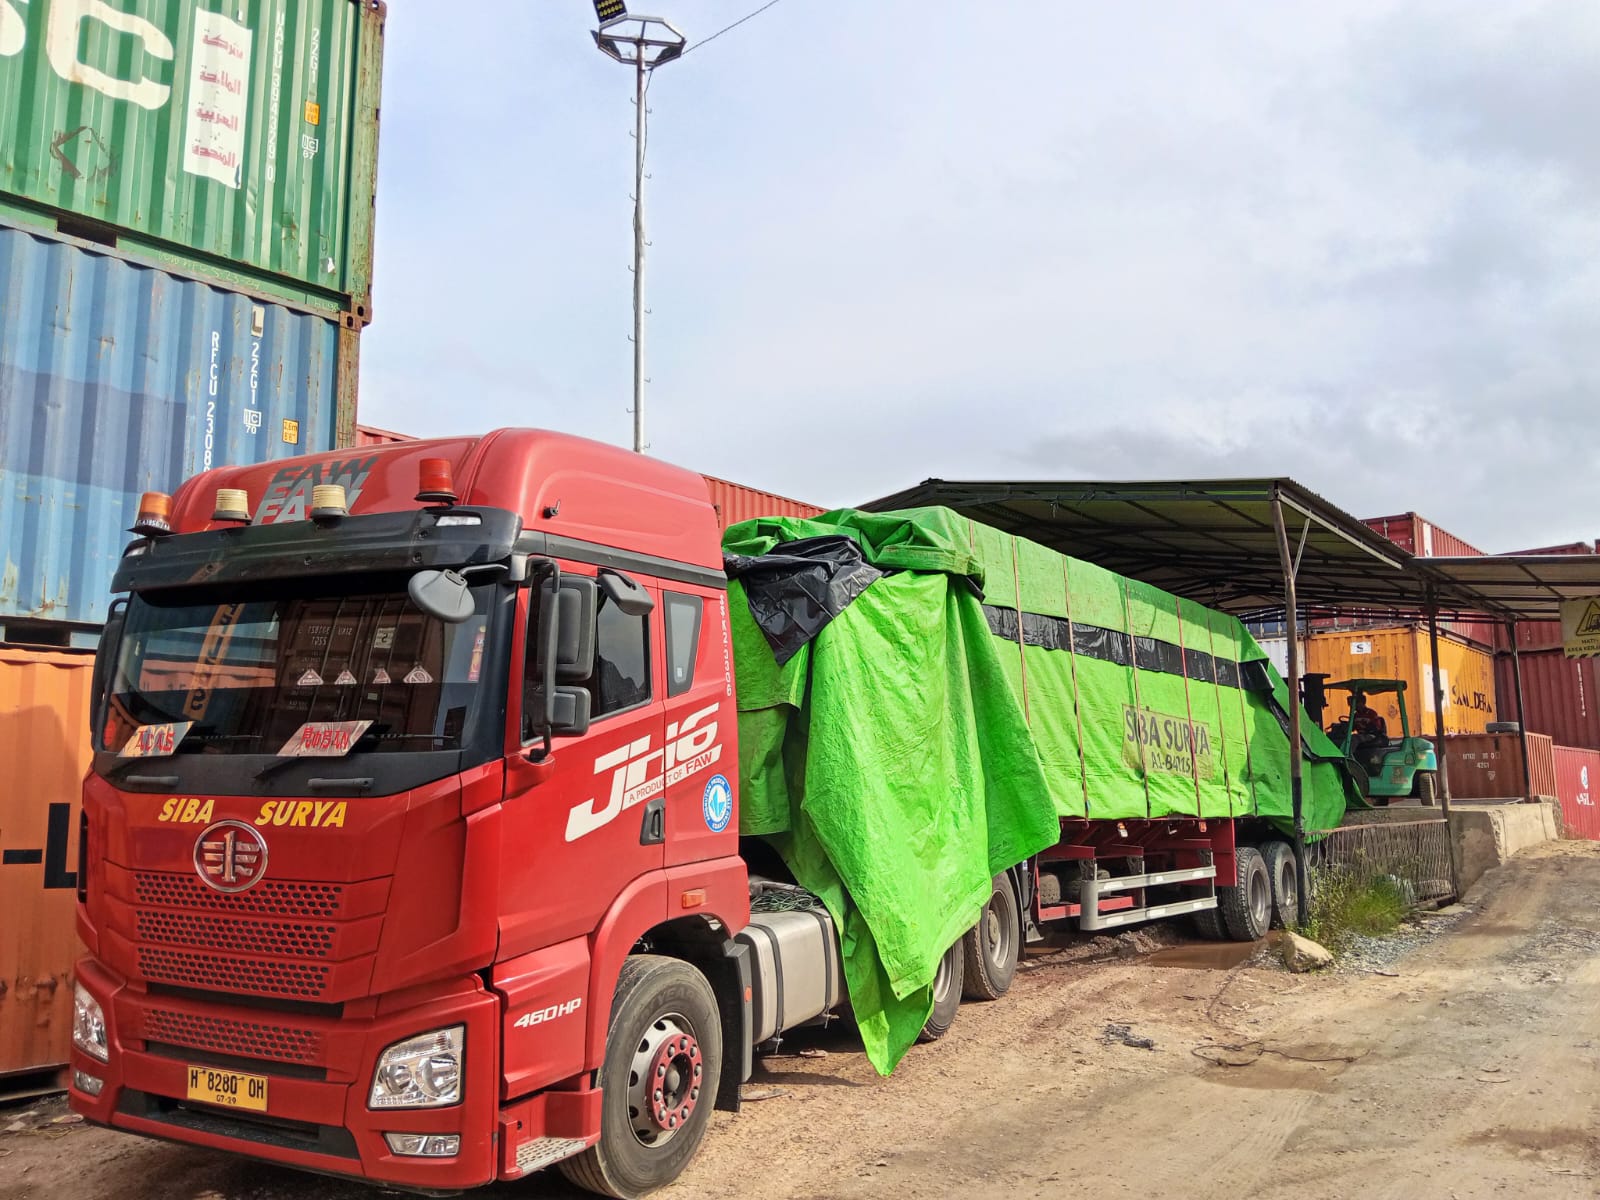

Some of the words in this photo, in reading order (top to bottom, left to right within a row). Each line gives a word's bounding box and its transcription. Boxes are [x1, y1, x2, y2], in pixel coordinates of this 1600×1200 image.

[274, 10, 285, 69] UACU
[208, 331, 220, 396] RFCU
[250, 342, 260, 405] 22G1
[1125, 710, 1161, 748] SIBA
[1163, 719, 1211, 756] SURYA
[565, 702, 720, 842] JH6
[628, 794, 636, 804] A
[636, 773, 673, 800] PRODUCT
[673, 769, 683, 781] OF
[685, 752, 713, 775] FAW
[158, 798, 215, 824] SIBA
[254, 801, 348, 828] SURYA
[190, 1069, 199, 1088] H
[207, 1072, 238, 1095] 8280
[248, 1078, 264, 1099] OH
